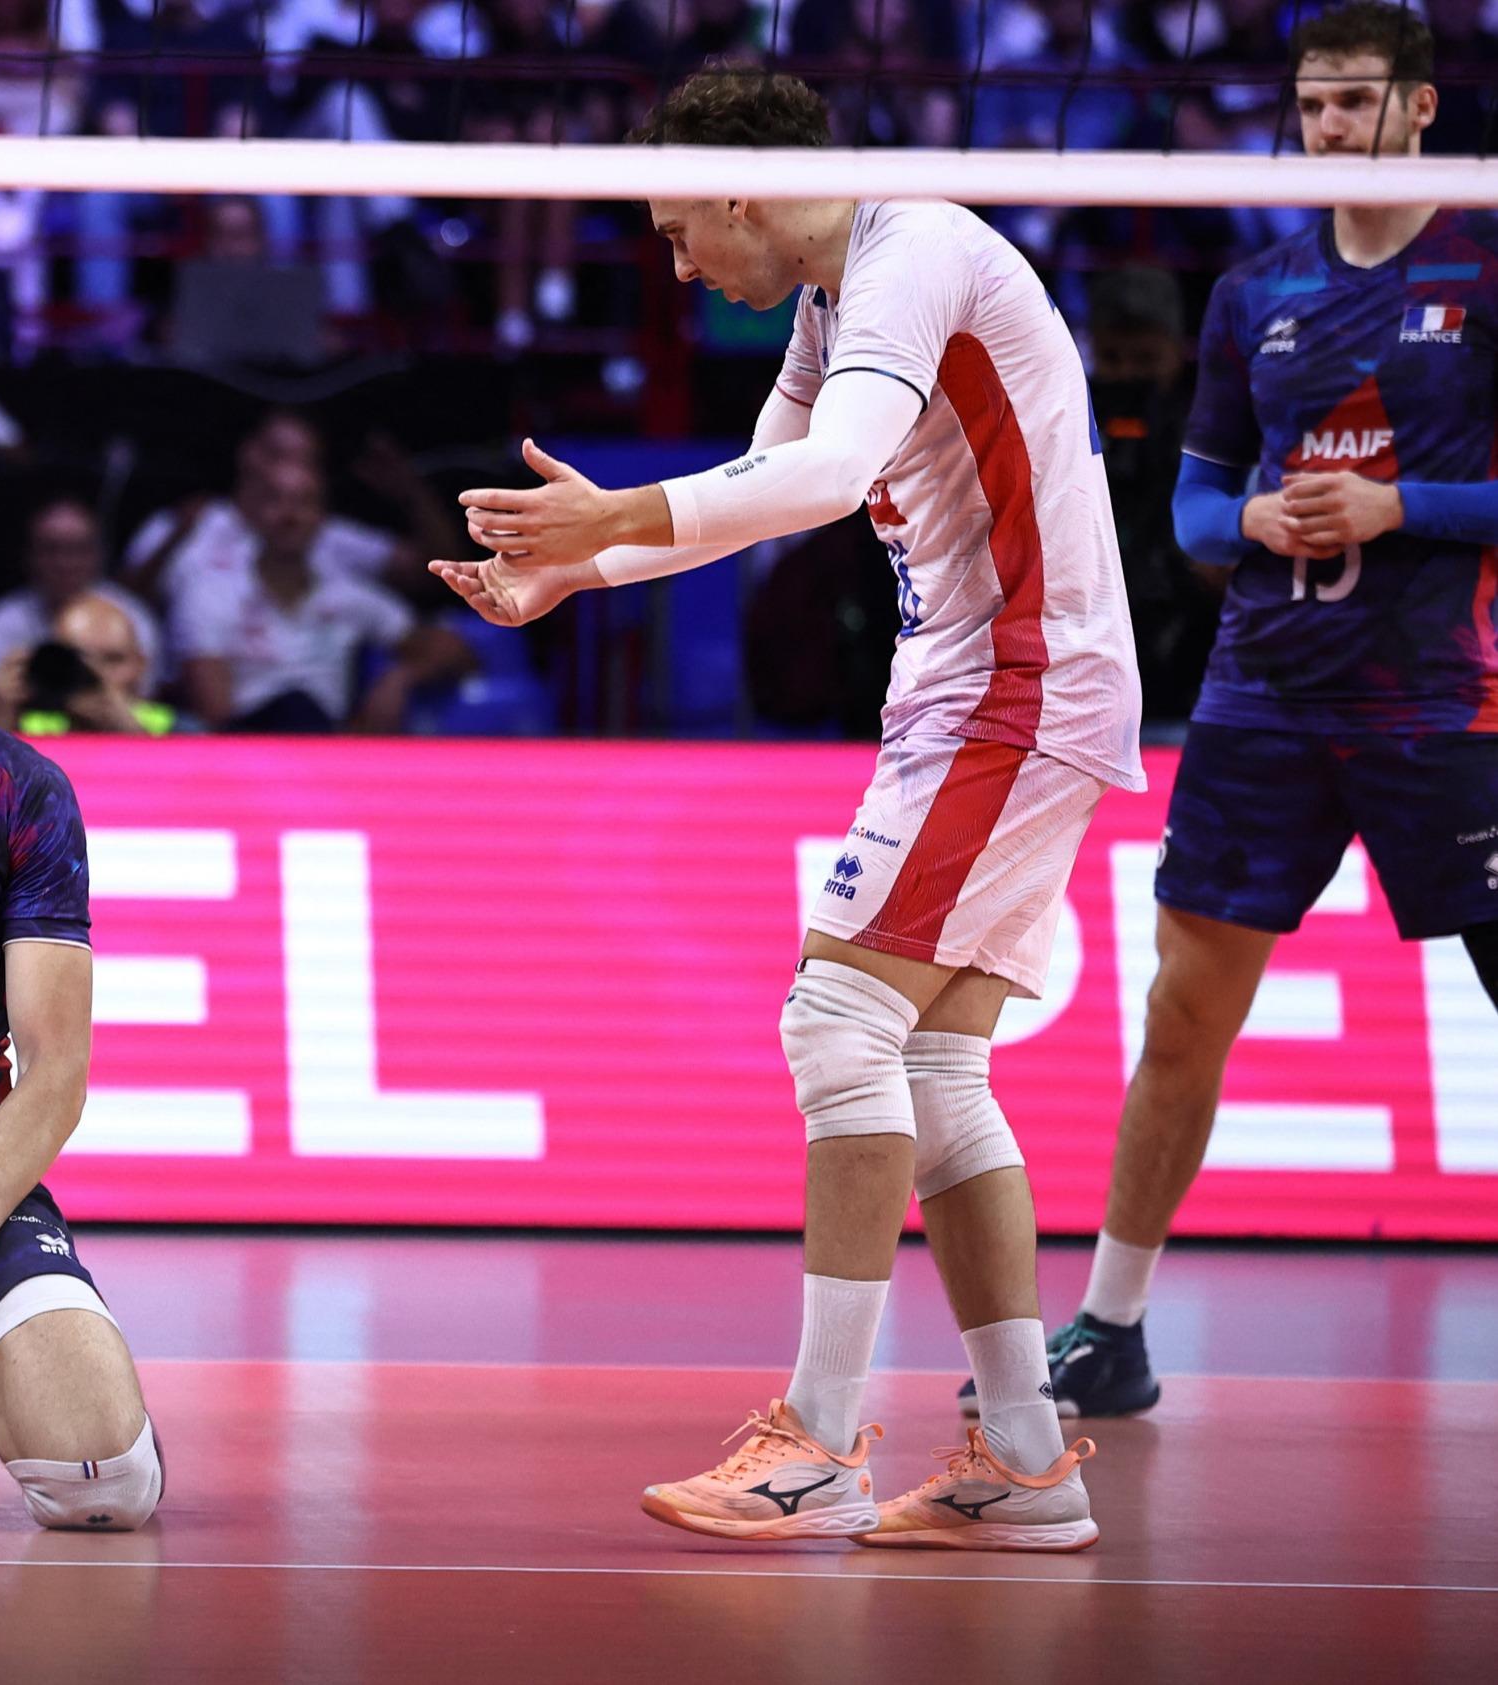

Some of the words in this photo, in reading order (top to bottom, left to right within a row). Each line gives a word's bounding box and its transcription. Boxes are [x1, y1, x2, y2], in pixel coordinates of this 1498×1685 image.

[1399, 332, 1462, 344] FRANCE
[1302, 430, 1394, 460] MAIF
[864, 830, 901, 849] Mutuel
